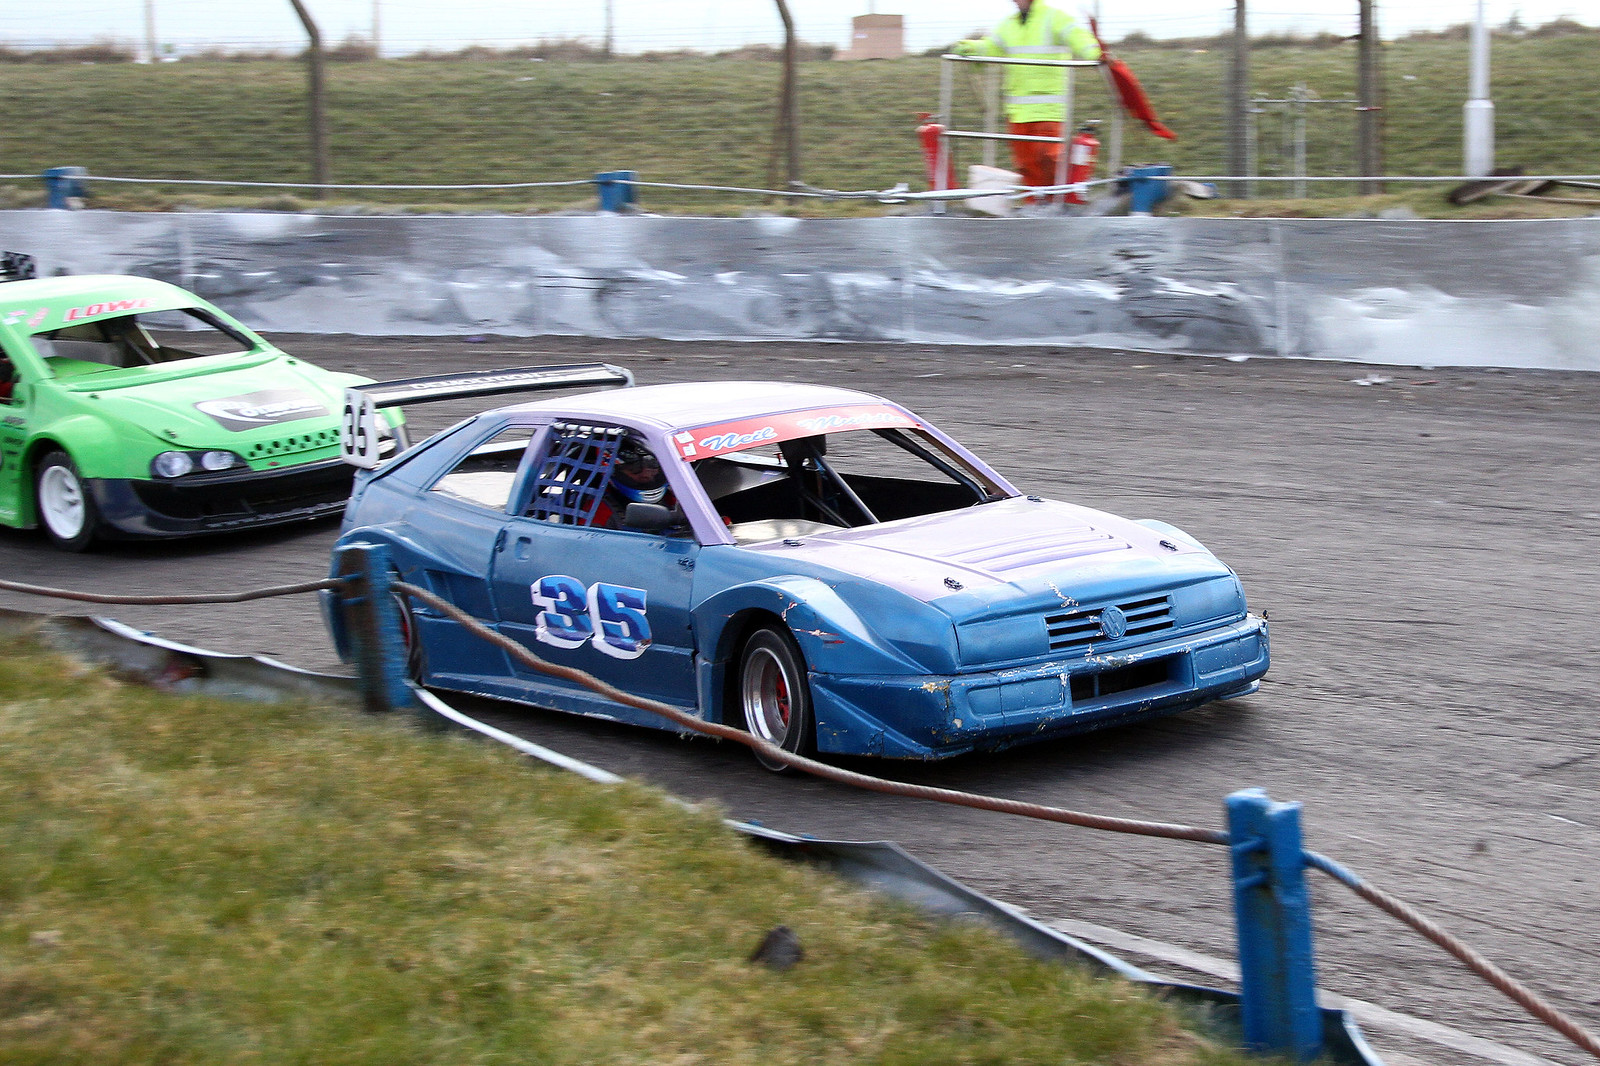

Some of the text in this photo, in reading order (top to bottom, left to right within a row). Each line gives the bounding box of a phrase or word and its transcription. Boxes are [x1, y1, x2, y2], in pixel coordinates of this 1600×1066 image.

[63, 297, 158, 323] LOWE
[698, 426, 778, 451] Neil
[530, 573, 652, 660] 35
